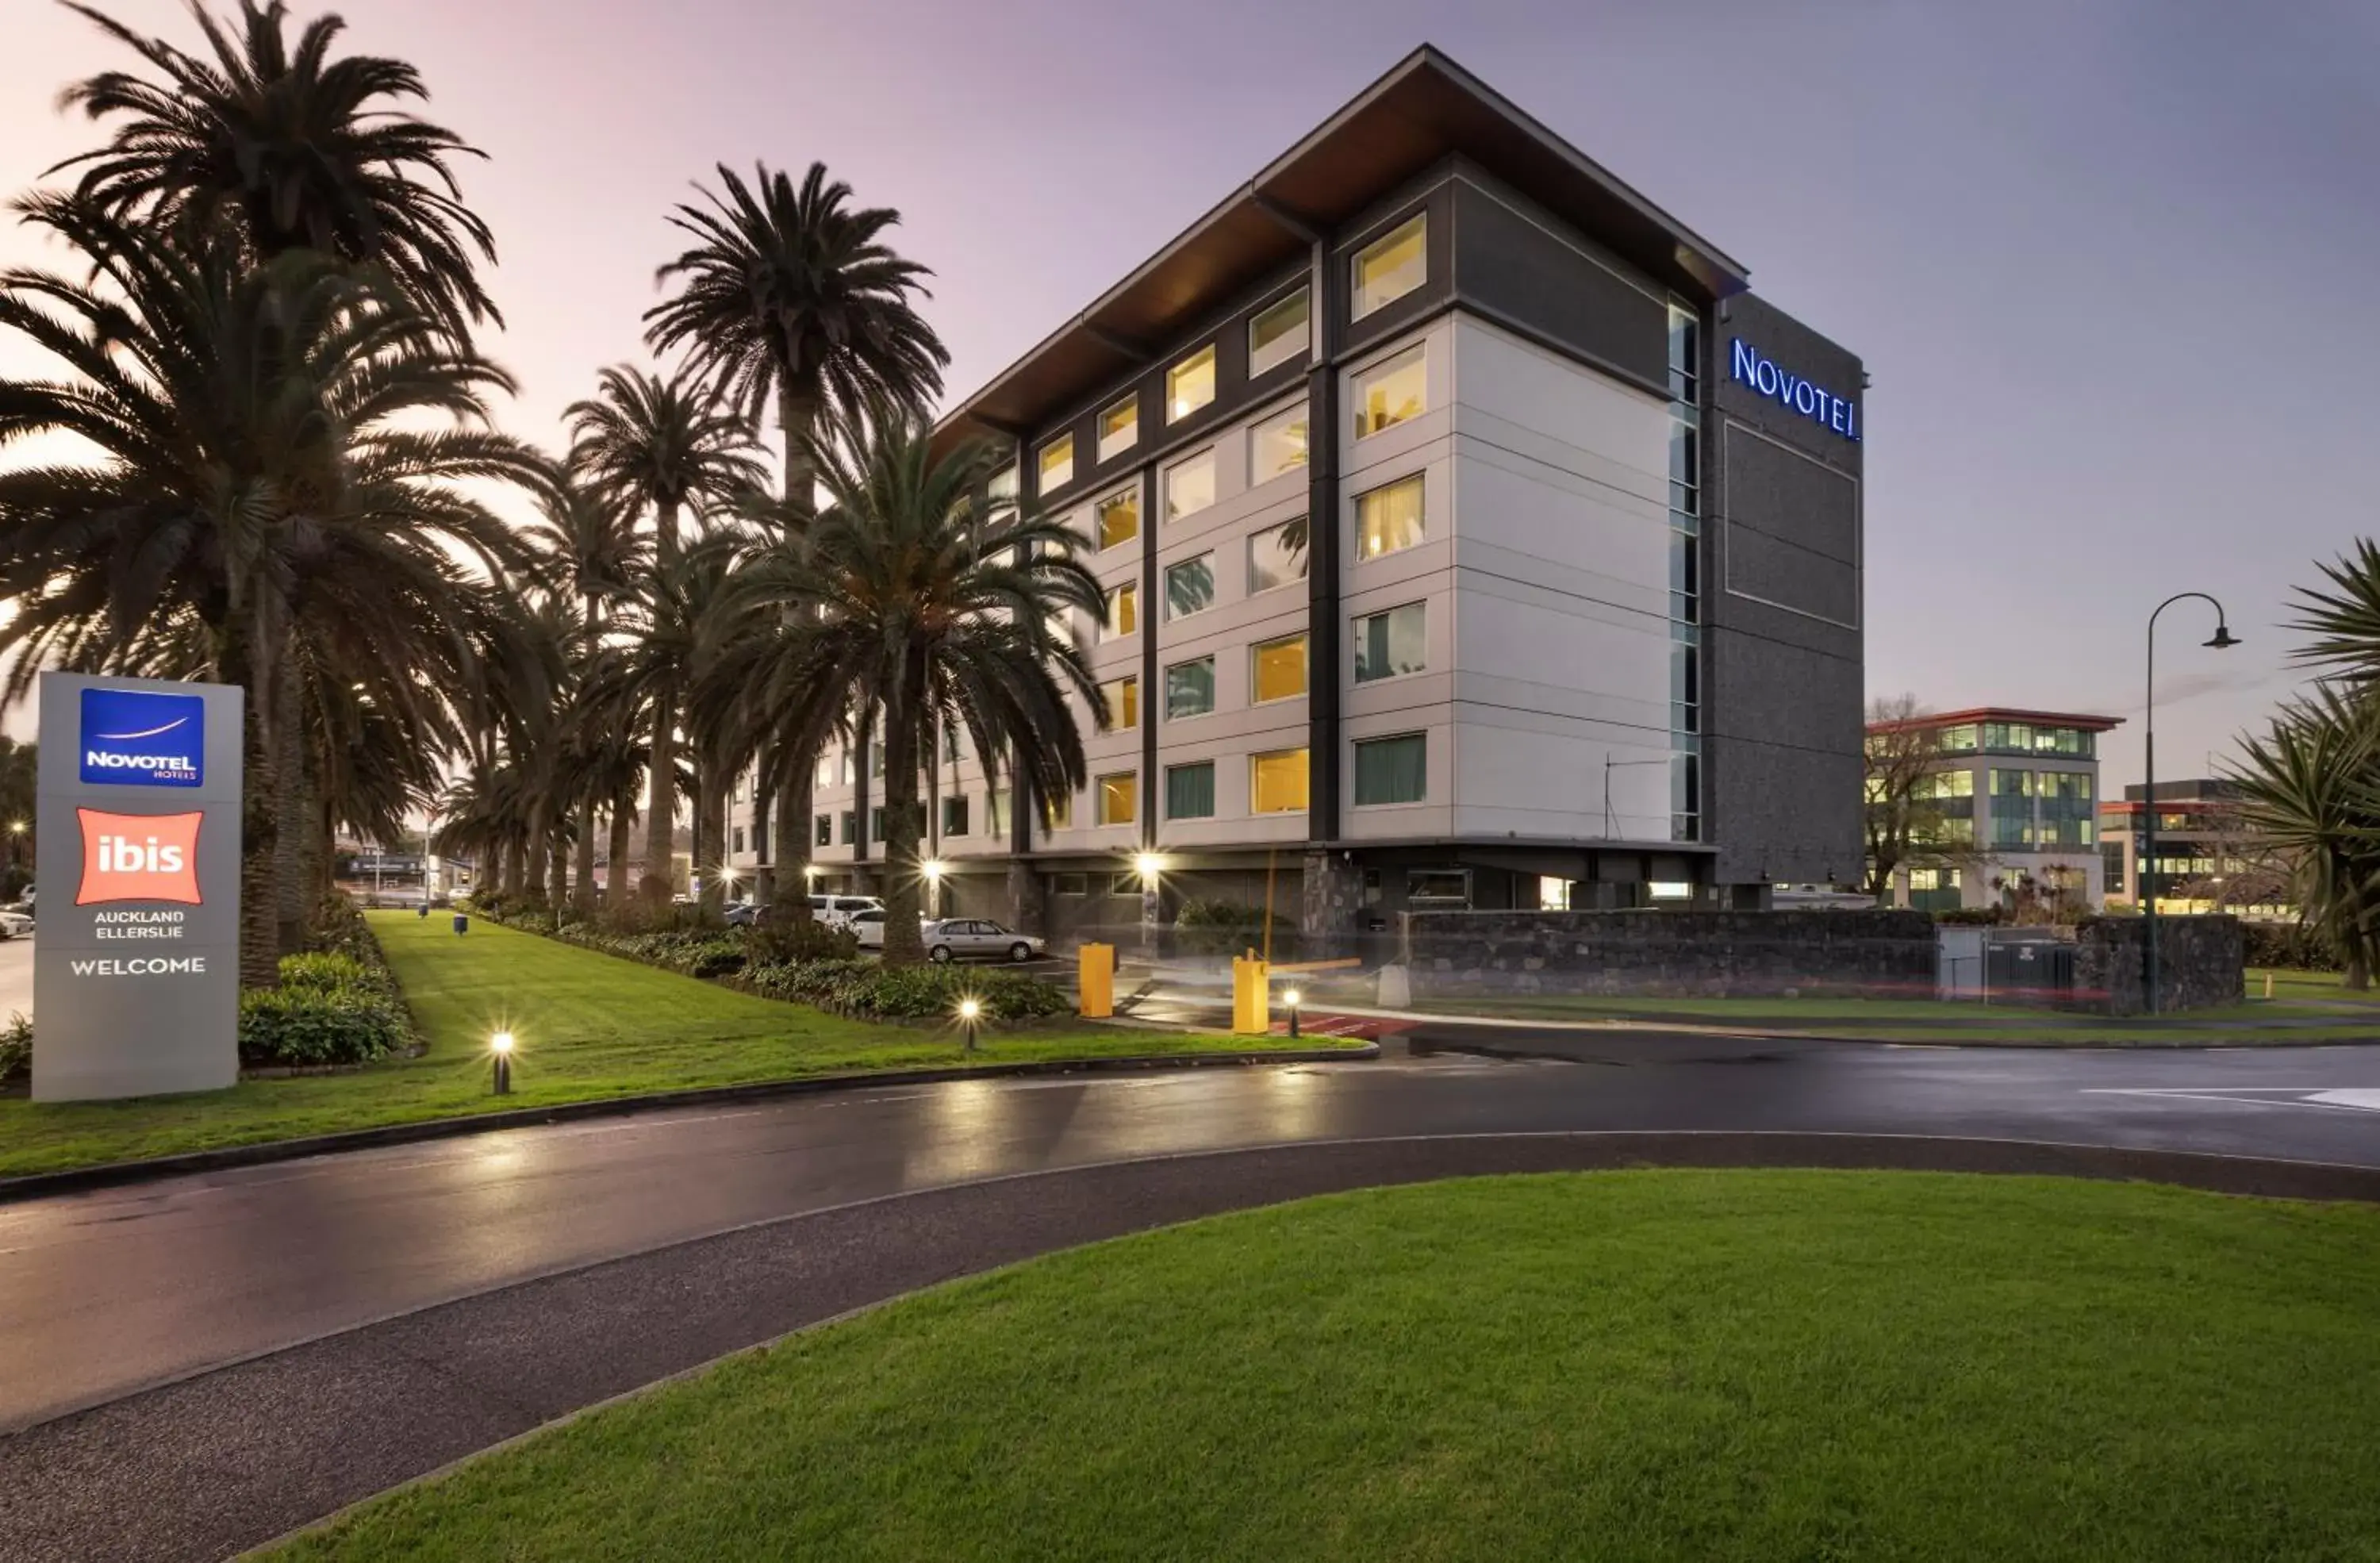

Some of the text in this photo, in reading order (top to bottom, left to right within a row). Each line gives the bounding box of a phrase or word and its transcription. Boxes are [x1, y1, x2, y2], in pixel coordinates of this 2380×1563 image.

[1731, 338, 1860, 440] NOVOTEL
[86, 751, 197, 770] NOVOTEL
[153, 770, 197, 780] HOTELS
[98, 835, 183, 873] ibis
[94, 911, 184, 924] AUCKLAND
[96, 926, 183, 939] ELLERSLIE
[70, 957, 206, 977] WELCOME
